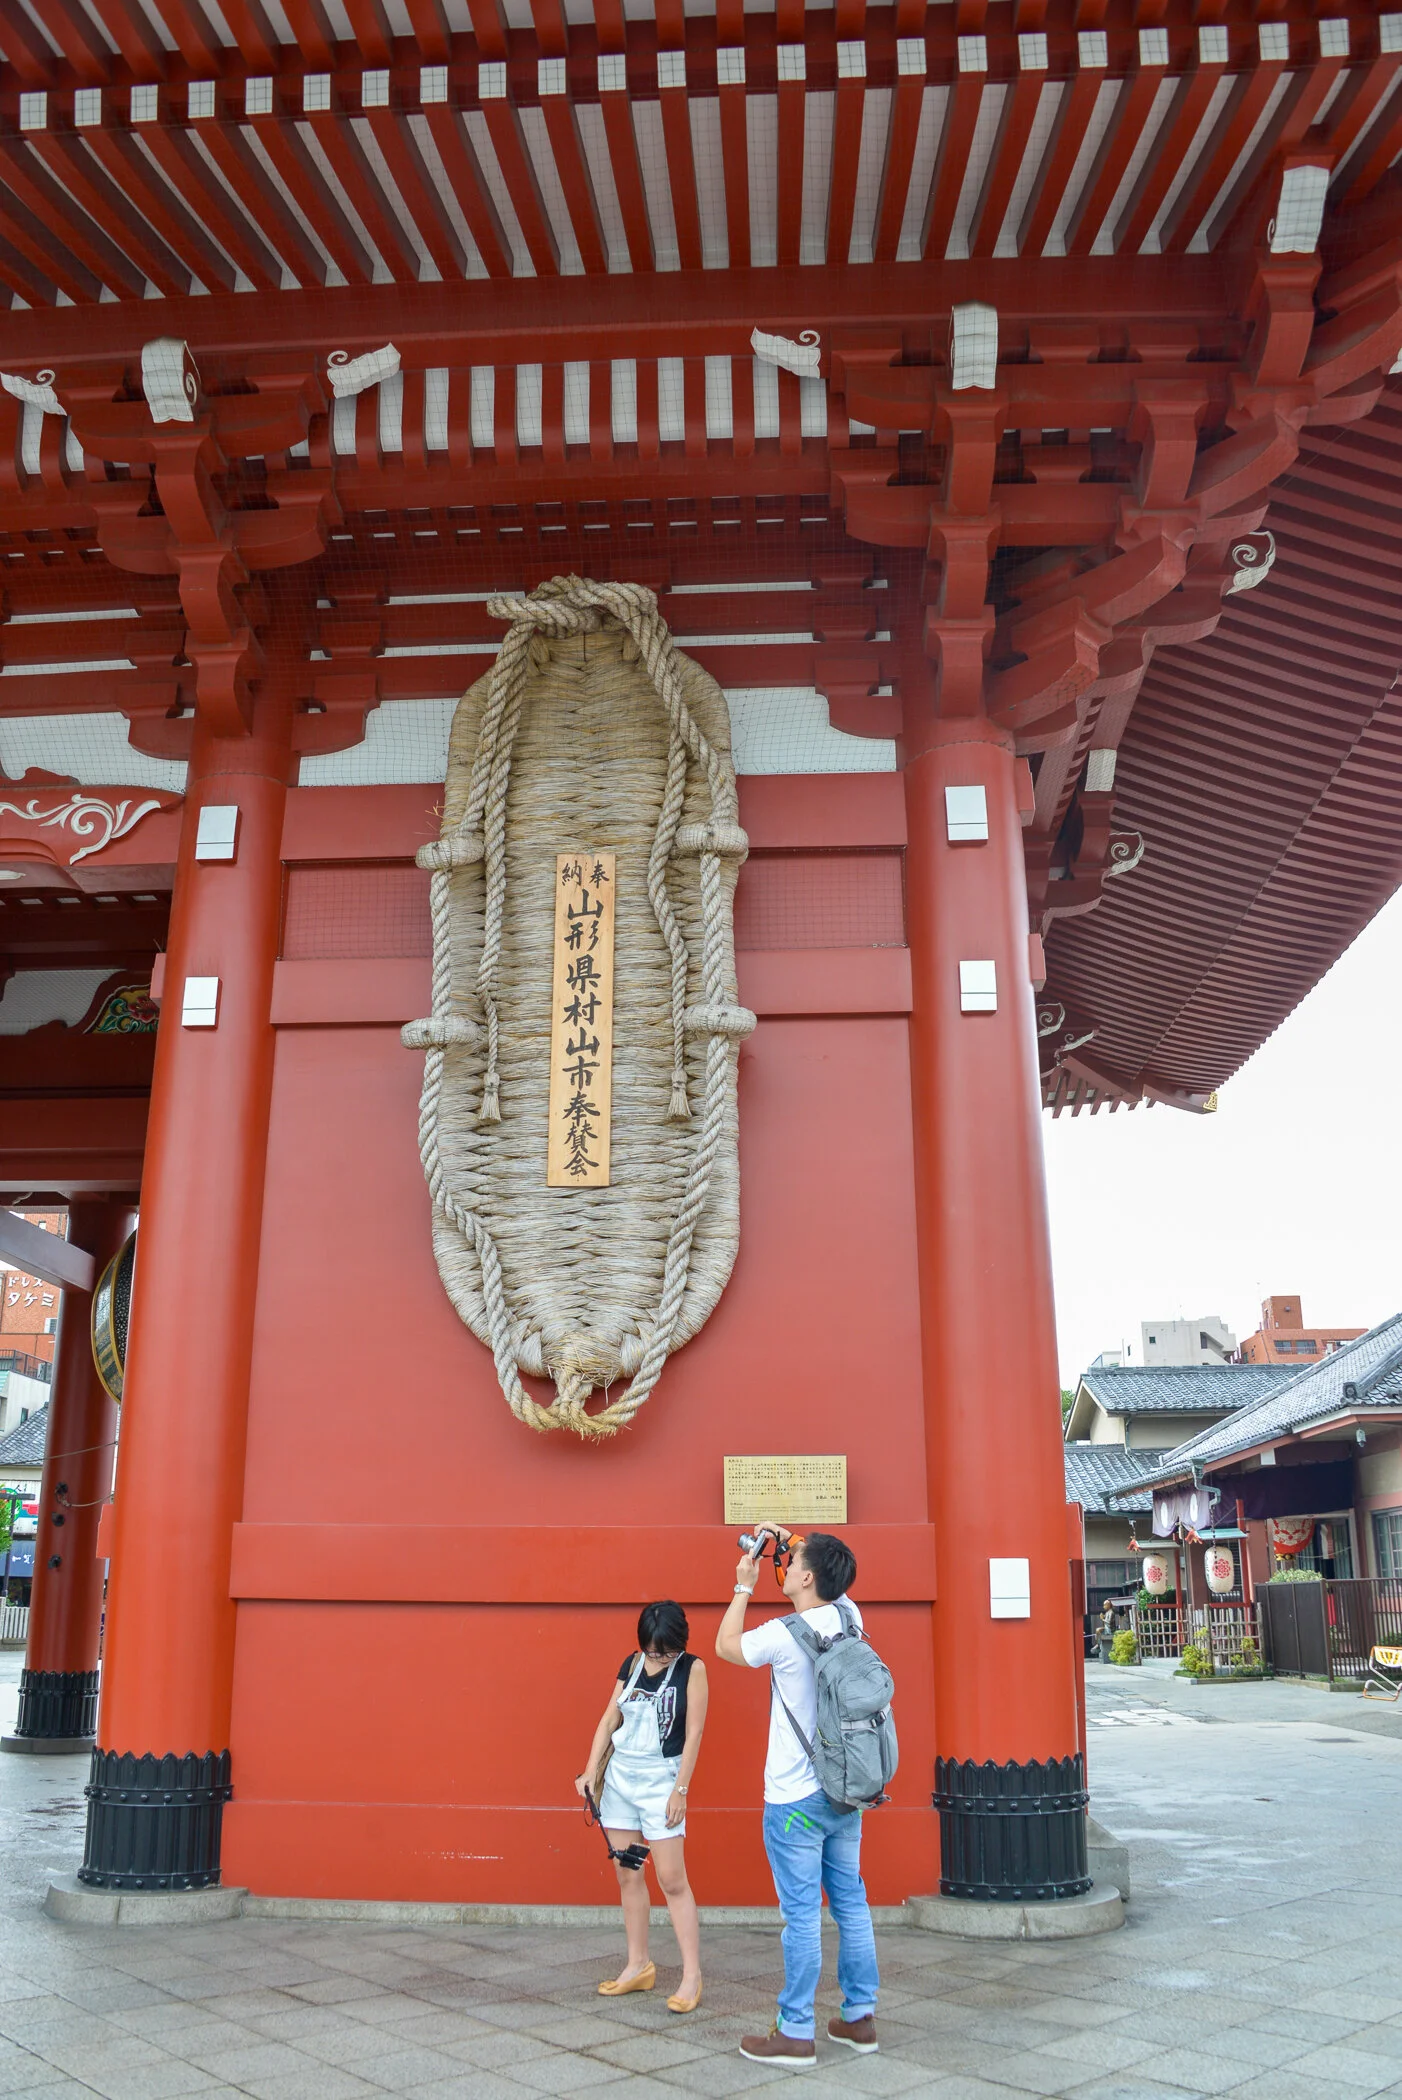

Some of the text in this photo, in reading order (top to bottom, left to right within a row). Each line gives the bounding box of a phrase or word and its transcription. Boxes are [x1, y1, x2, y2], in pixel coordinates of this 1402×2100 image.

[561, 888, 604, 1176] 山形県村山市奉賛会
[8, 1292, 54, 1308] タケミ
